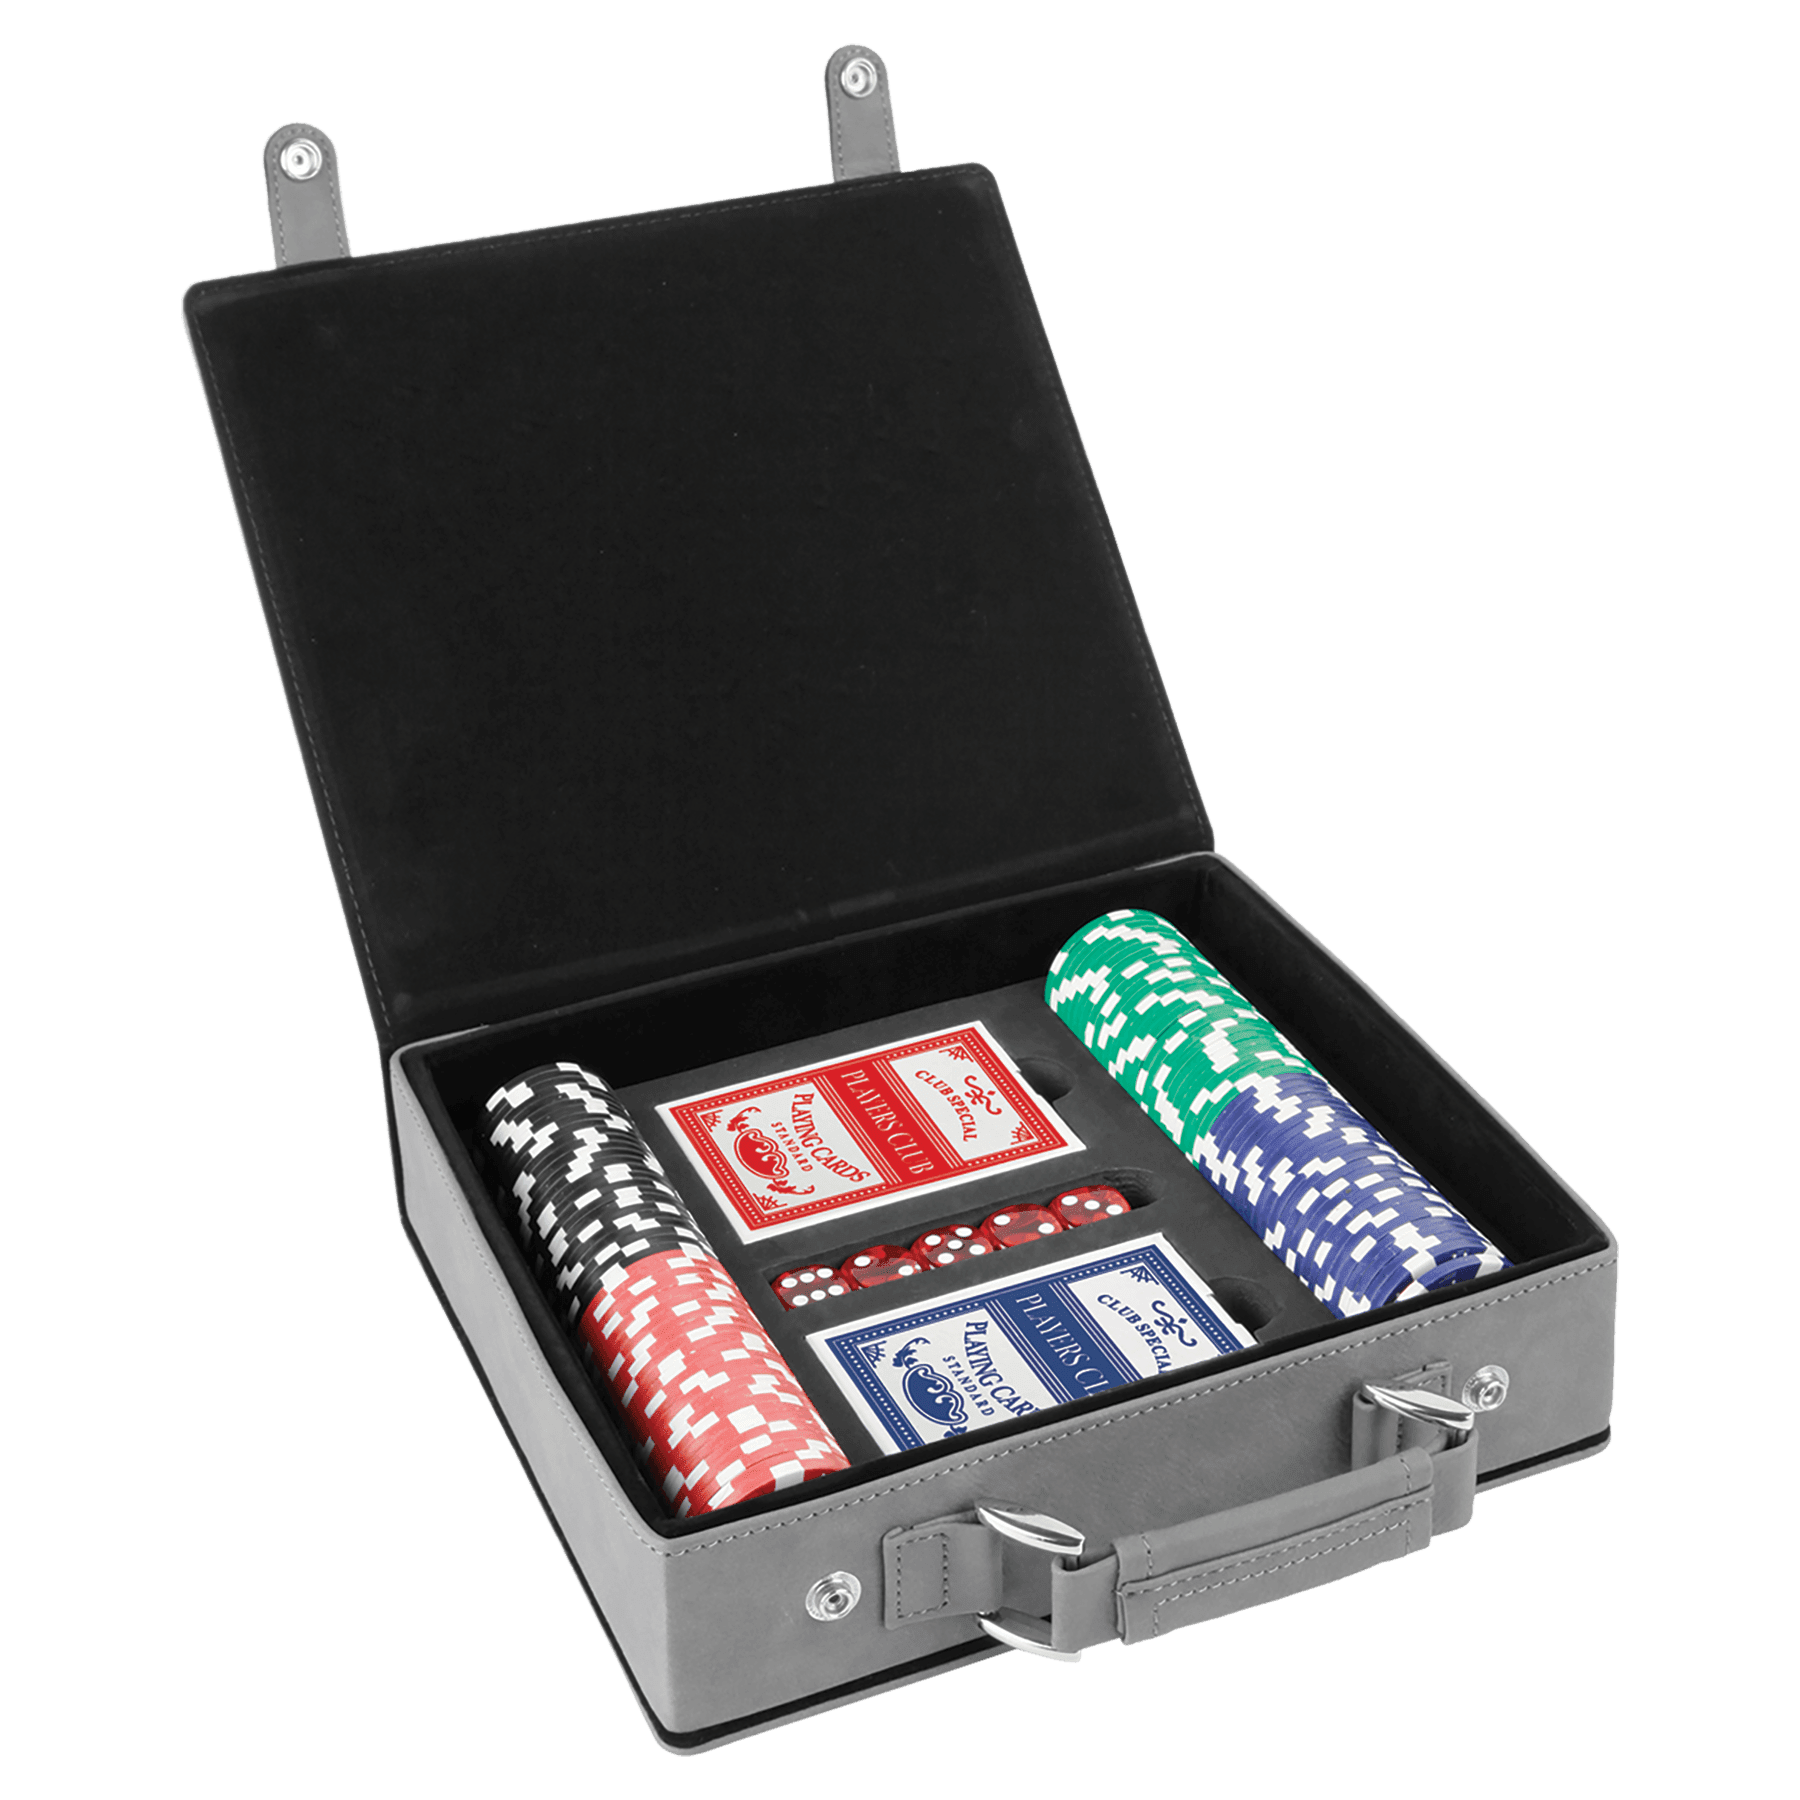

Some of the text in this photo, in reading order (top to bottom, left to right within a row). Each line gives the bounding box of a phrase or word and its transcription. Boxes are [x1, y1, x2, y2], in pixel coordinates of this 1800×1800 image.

[771, 1121, 813, 1172] STANDARD
[791, 1093, 871, 1182] PLAYING CARDS
[841, 1069, 934, 1174] PLAYERS CLUB
[914, 1069, 978, 1142] CLUB SPECIAL
[964, 1321, 1040, 1417] PLAYING CAR
[1015, 1293, 1110, 1397] PLAYERS CL
[1097, 1294, 1173, 1375] CLUB SPECIA
[942, 1355, 995, 1416] STANDARD
